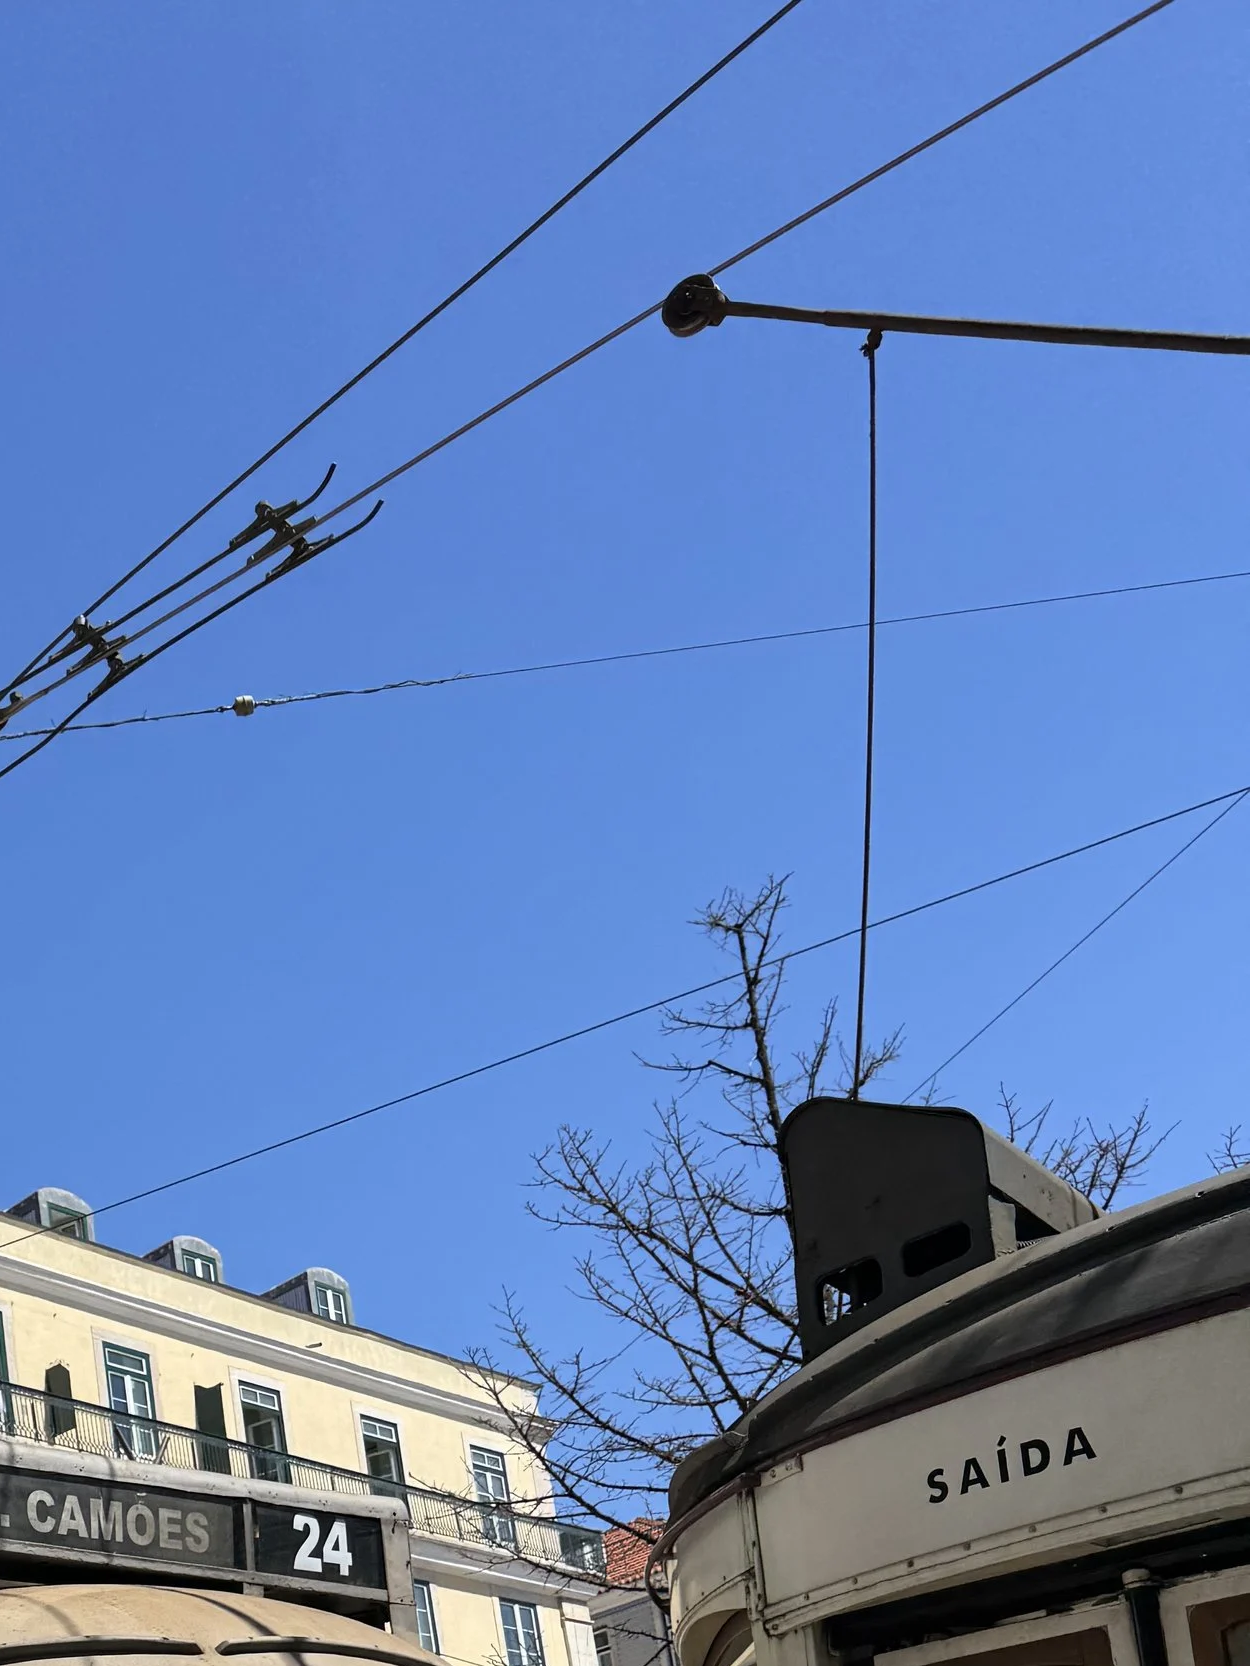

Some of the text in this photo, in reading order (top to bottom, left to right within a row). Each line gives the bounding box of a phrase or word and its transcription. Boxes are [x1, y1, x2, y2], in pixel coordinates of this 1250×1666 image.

[927, 1427, 1097, 1504] SAÍDA
[26, 1489, 211, 1554] CAMÕES
[293, 1514, 353, 1576] 24
